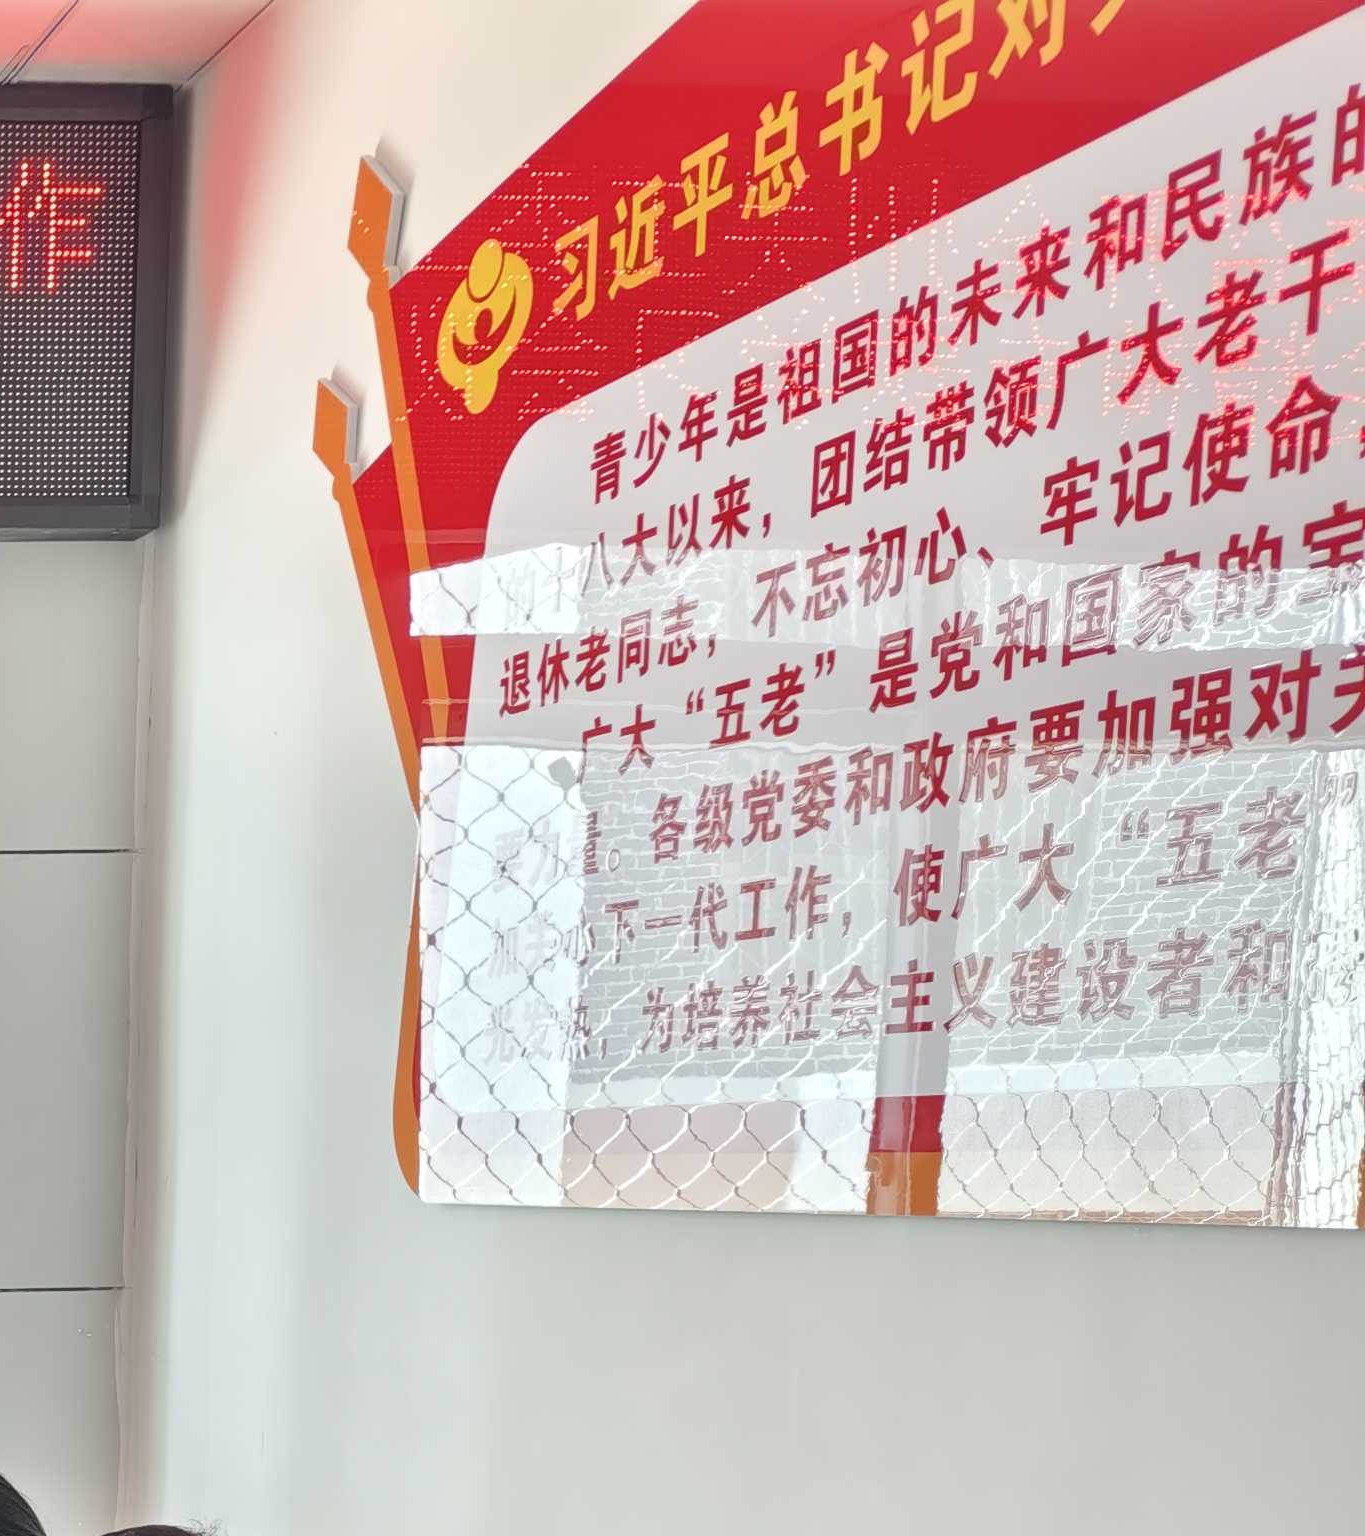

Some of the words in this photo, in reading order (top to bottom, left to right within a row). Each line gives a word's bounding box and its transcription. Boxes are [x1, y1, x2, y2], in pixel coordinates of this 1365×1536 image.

[552, 0, 1123, 321] 习近平总书记对
[500, 374, 1365, 716] 退休老同志，不忘初心、牢记使命
